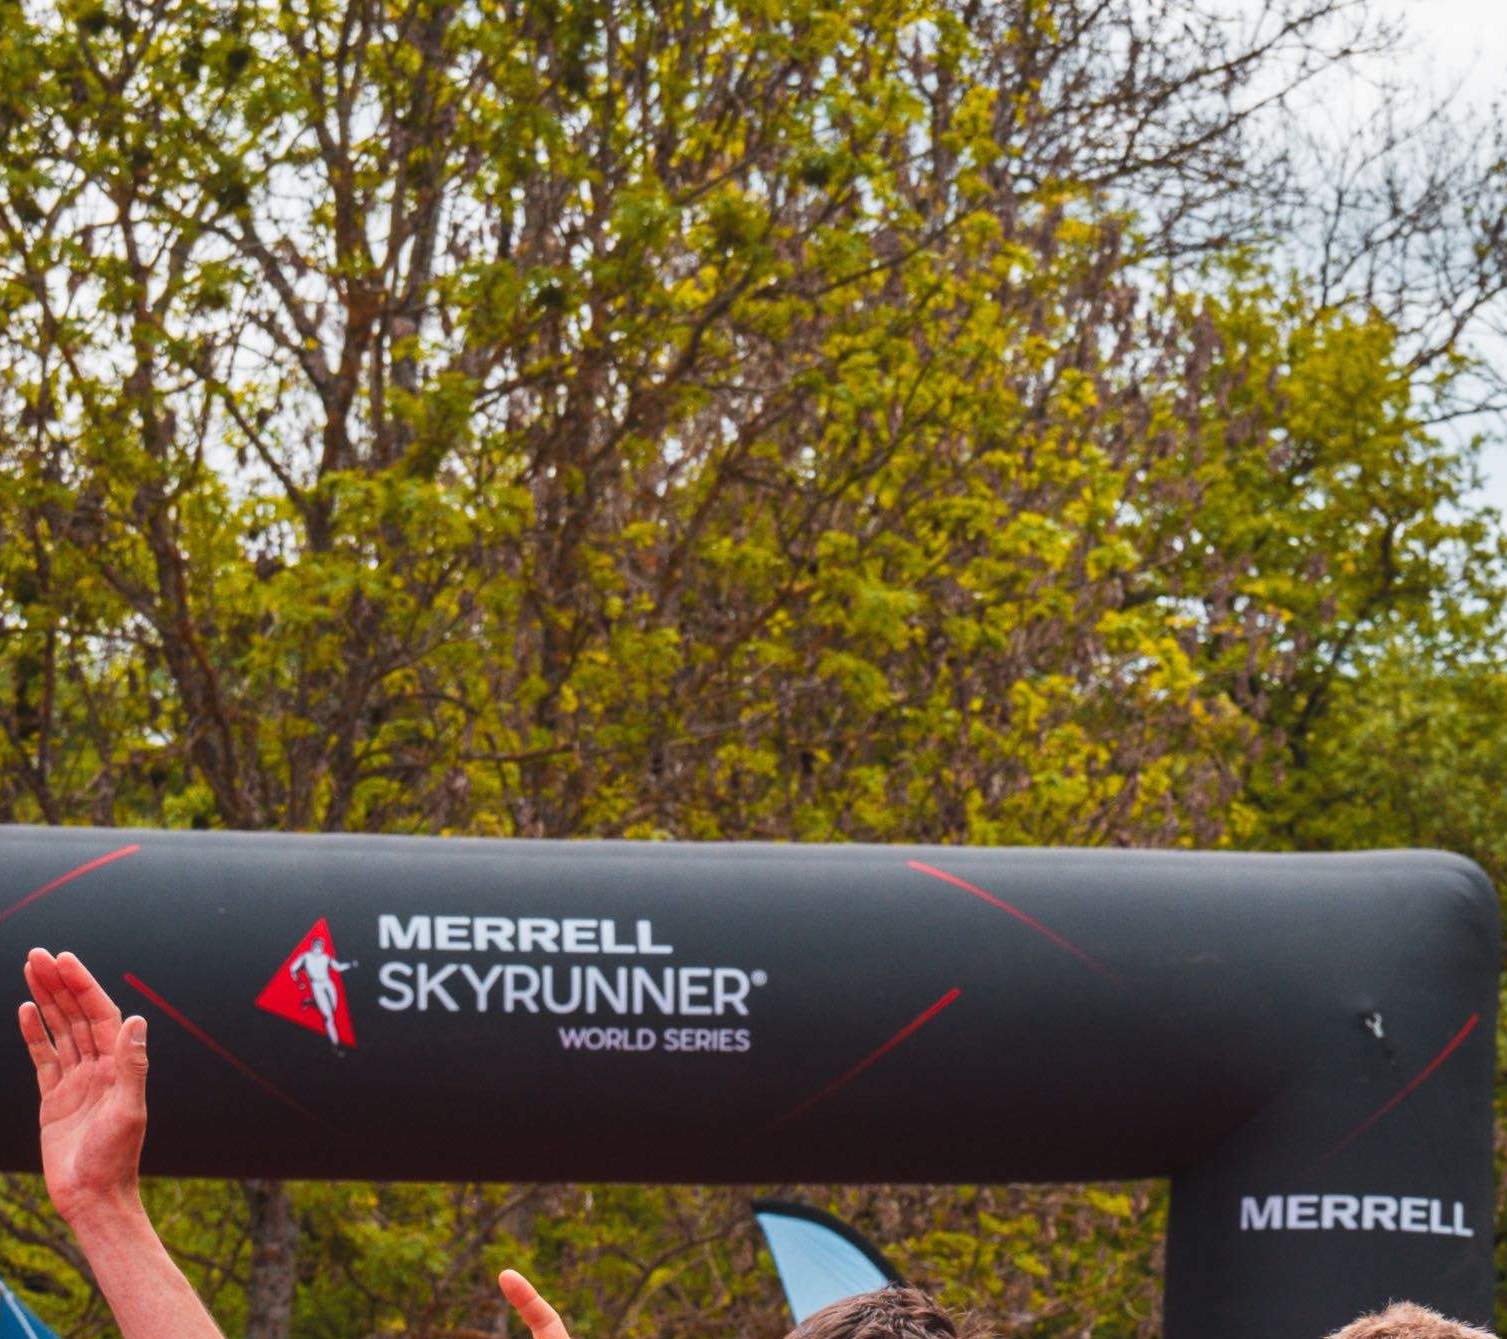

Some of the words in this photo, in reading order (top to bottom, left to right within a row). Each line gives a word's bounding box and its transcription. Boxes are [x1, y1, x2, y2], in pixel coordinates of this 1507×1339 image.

[378, 914, 674, 954] MERRELL
[558, 1026, 655, 1052] WORLD
[664, 1028, 751, 1052] SERIES
[1240, 1194, 1474, 1238] MERRELL
